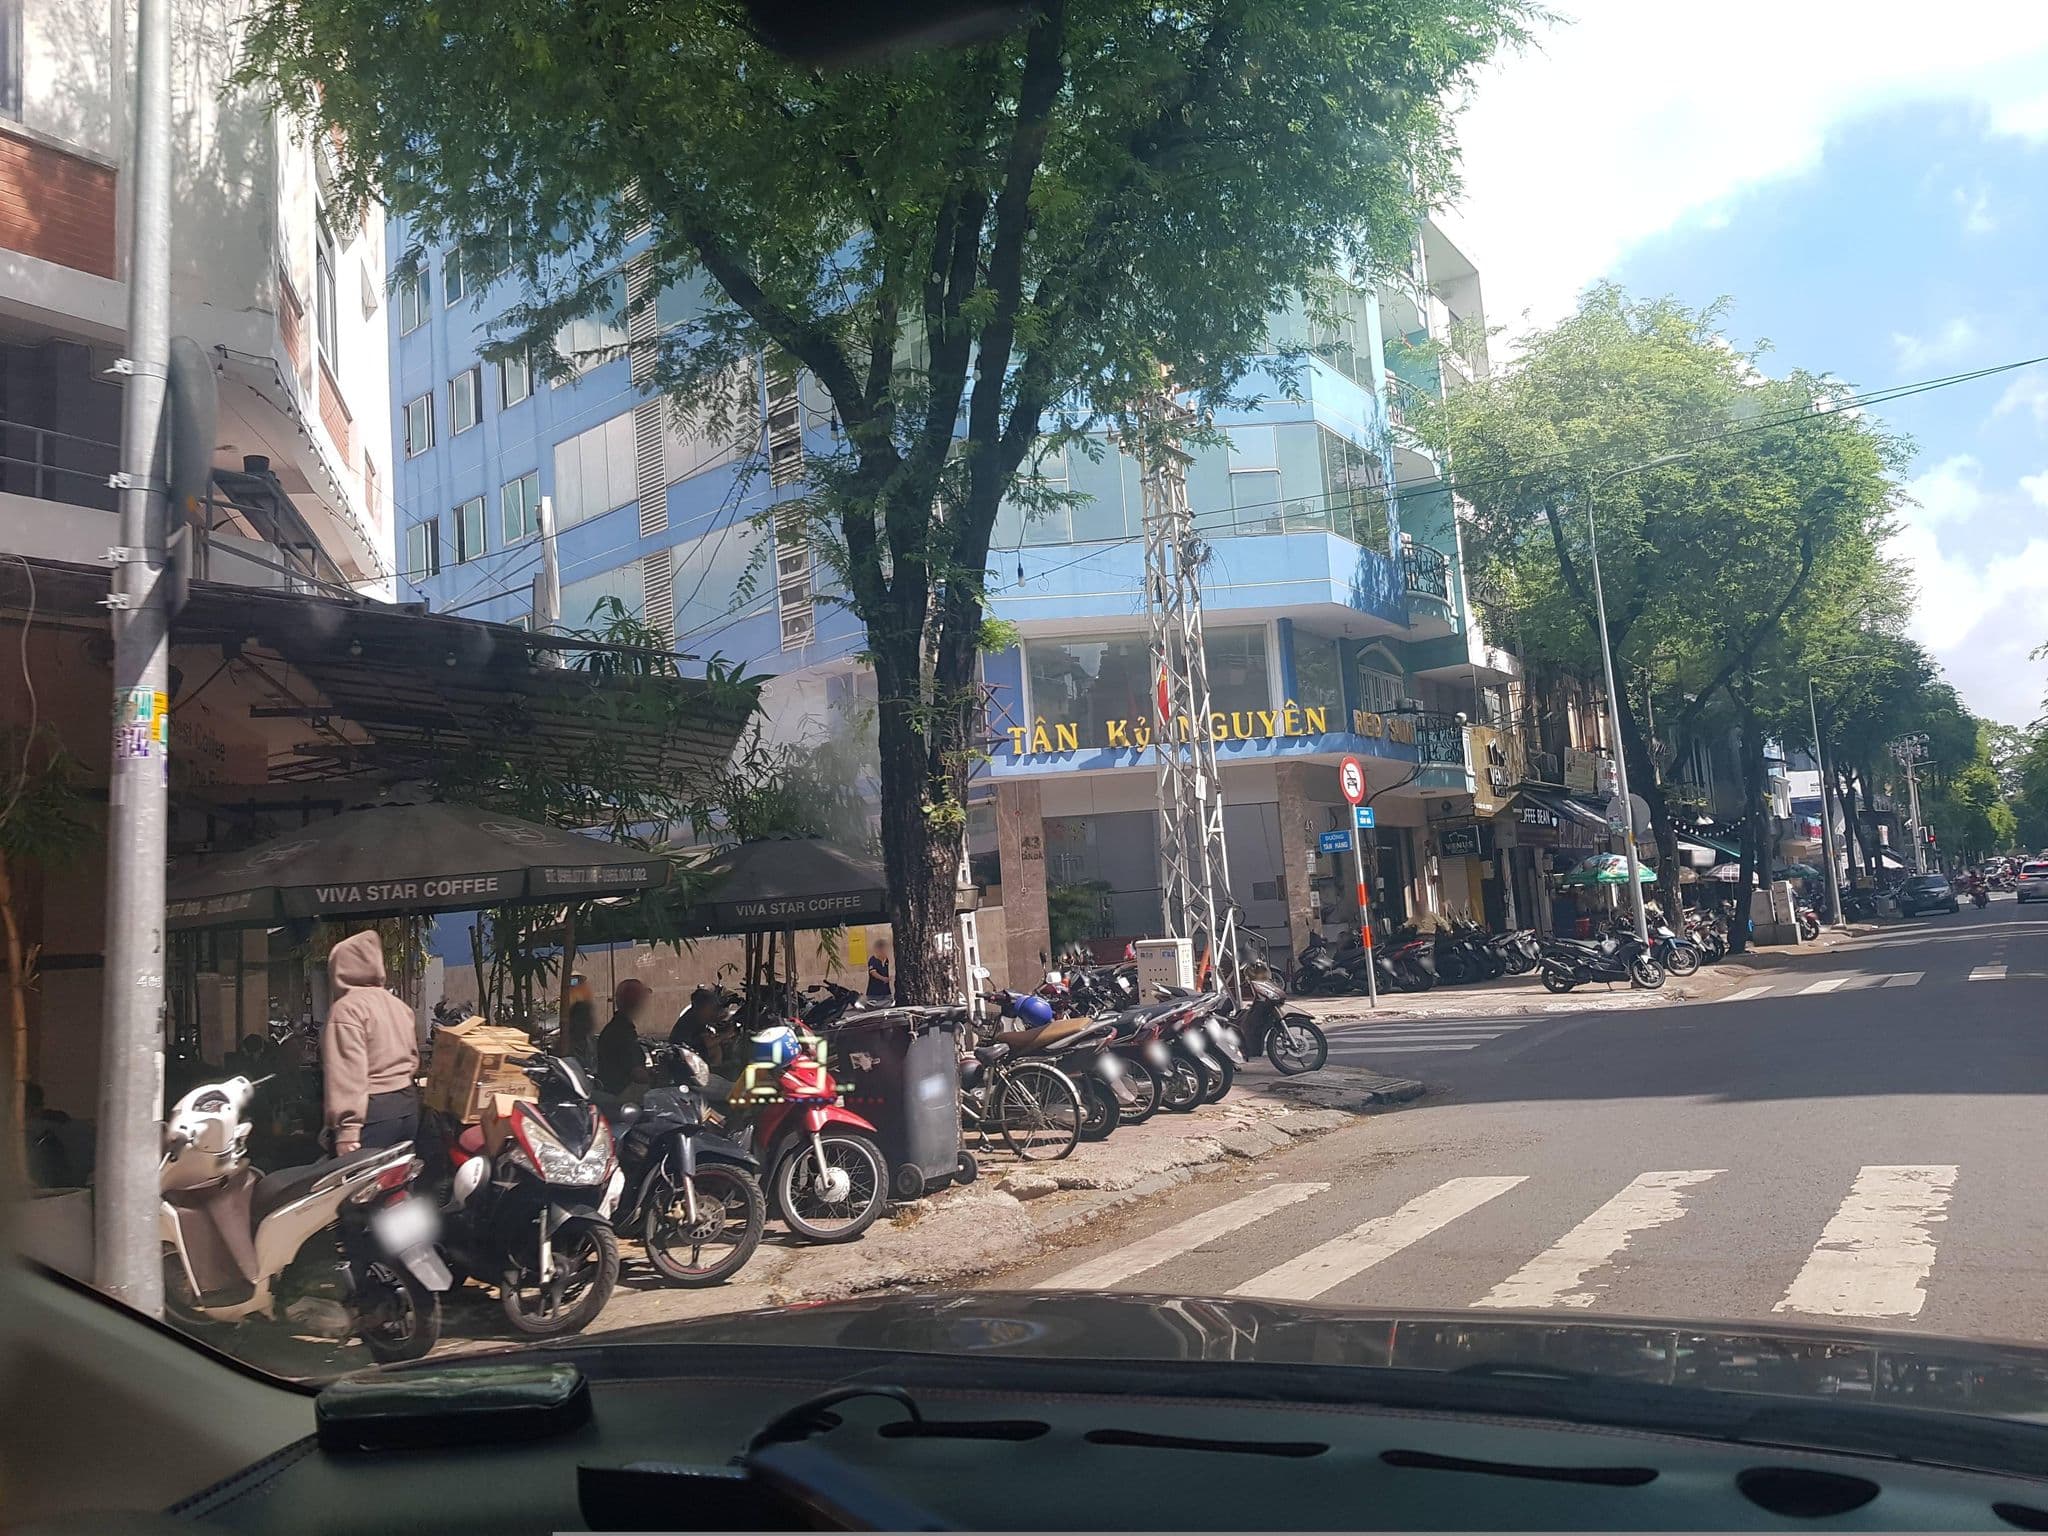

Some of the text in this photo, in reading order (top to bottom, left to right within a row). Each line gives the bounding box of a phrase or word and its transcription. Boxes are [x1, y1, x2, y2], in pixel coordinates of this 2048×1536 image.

[1007, 715, 1079, 755] TÂN
[1177, 699, 1327, 741] NGUYÊN
[316, 877, 499, 903] VIVA STAR COFFEE
[736, 896, 861, 916] VIVA STAR COFFEE
